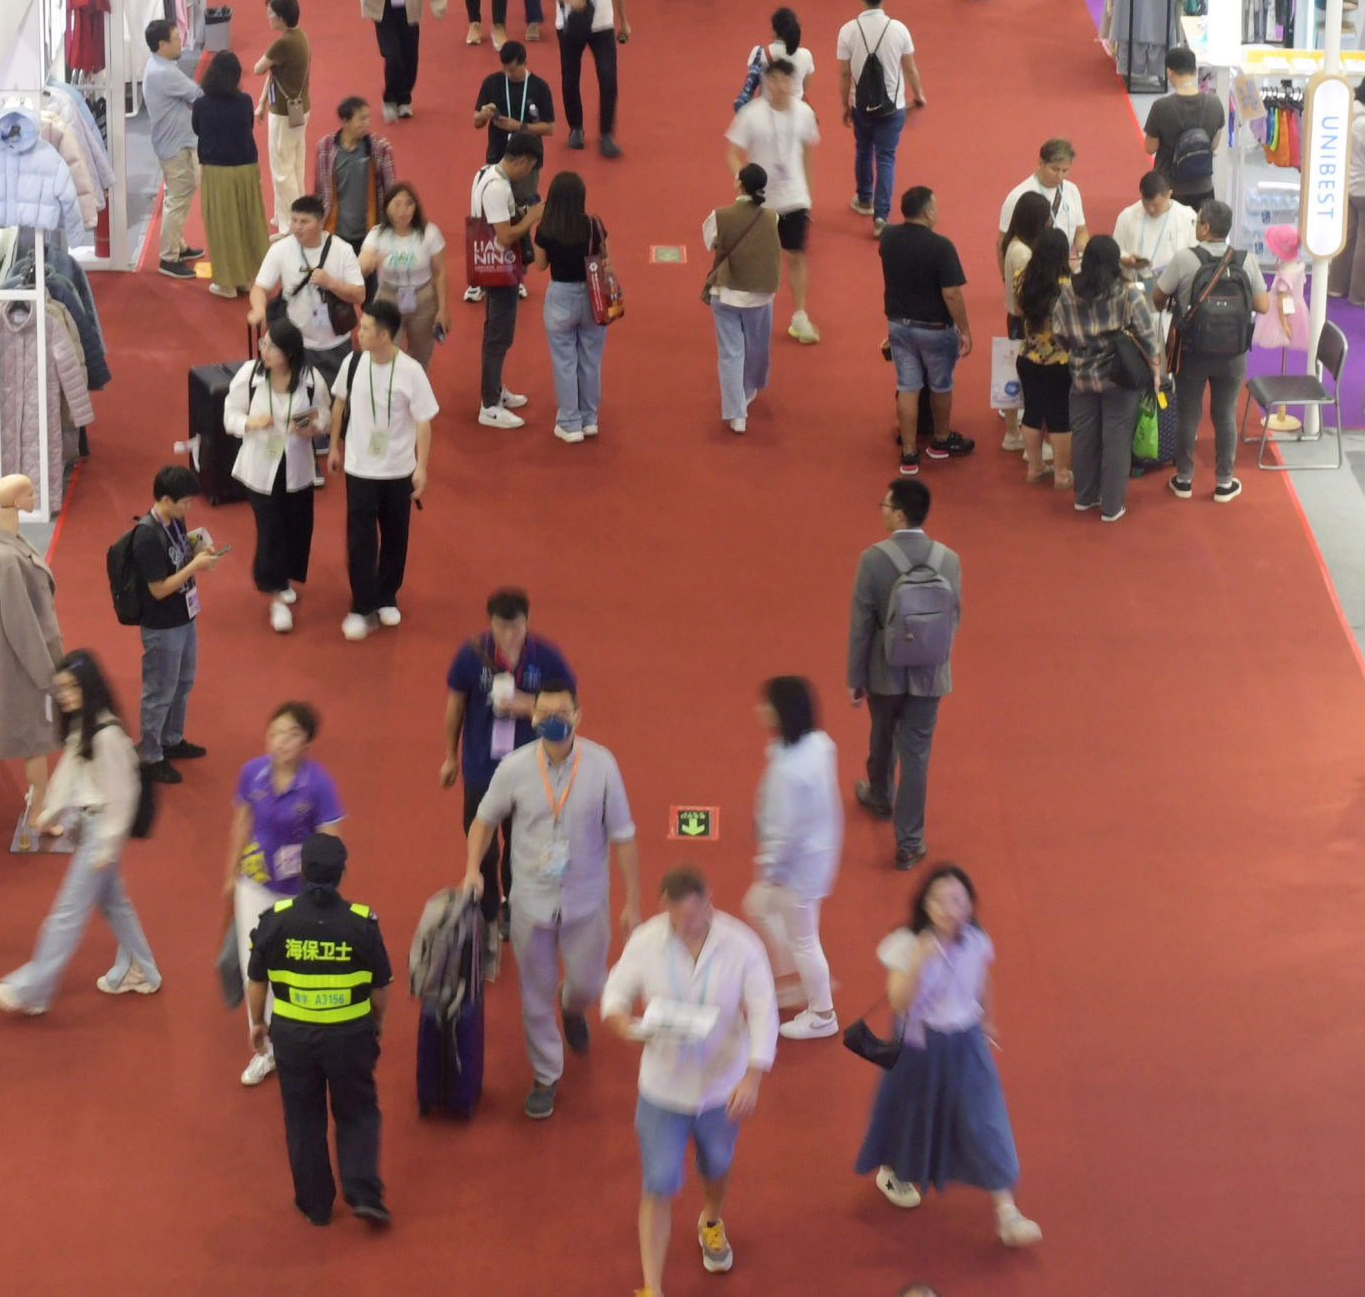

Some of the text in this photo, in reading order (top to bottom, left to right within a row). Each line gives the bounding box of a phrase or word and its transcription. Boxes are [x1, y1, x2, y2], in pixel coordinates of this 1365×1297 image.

[1316, 115, 1340, 219] UNIBEST
[285, 938, 353, 961] 海保卫士
